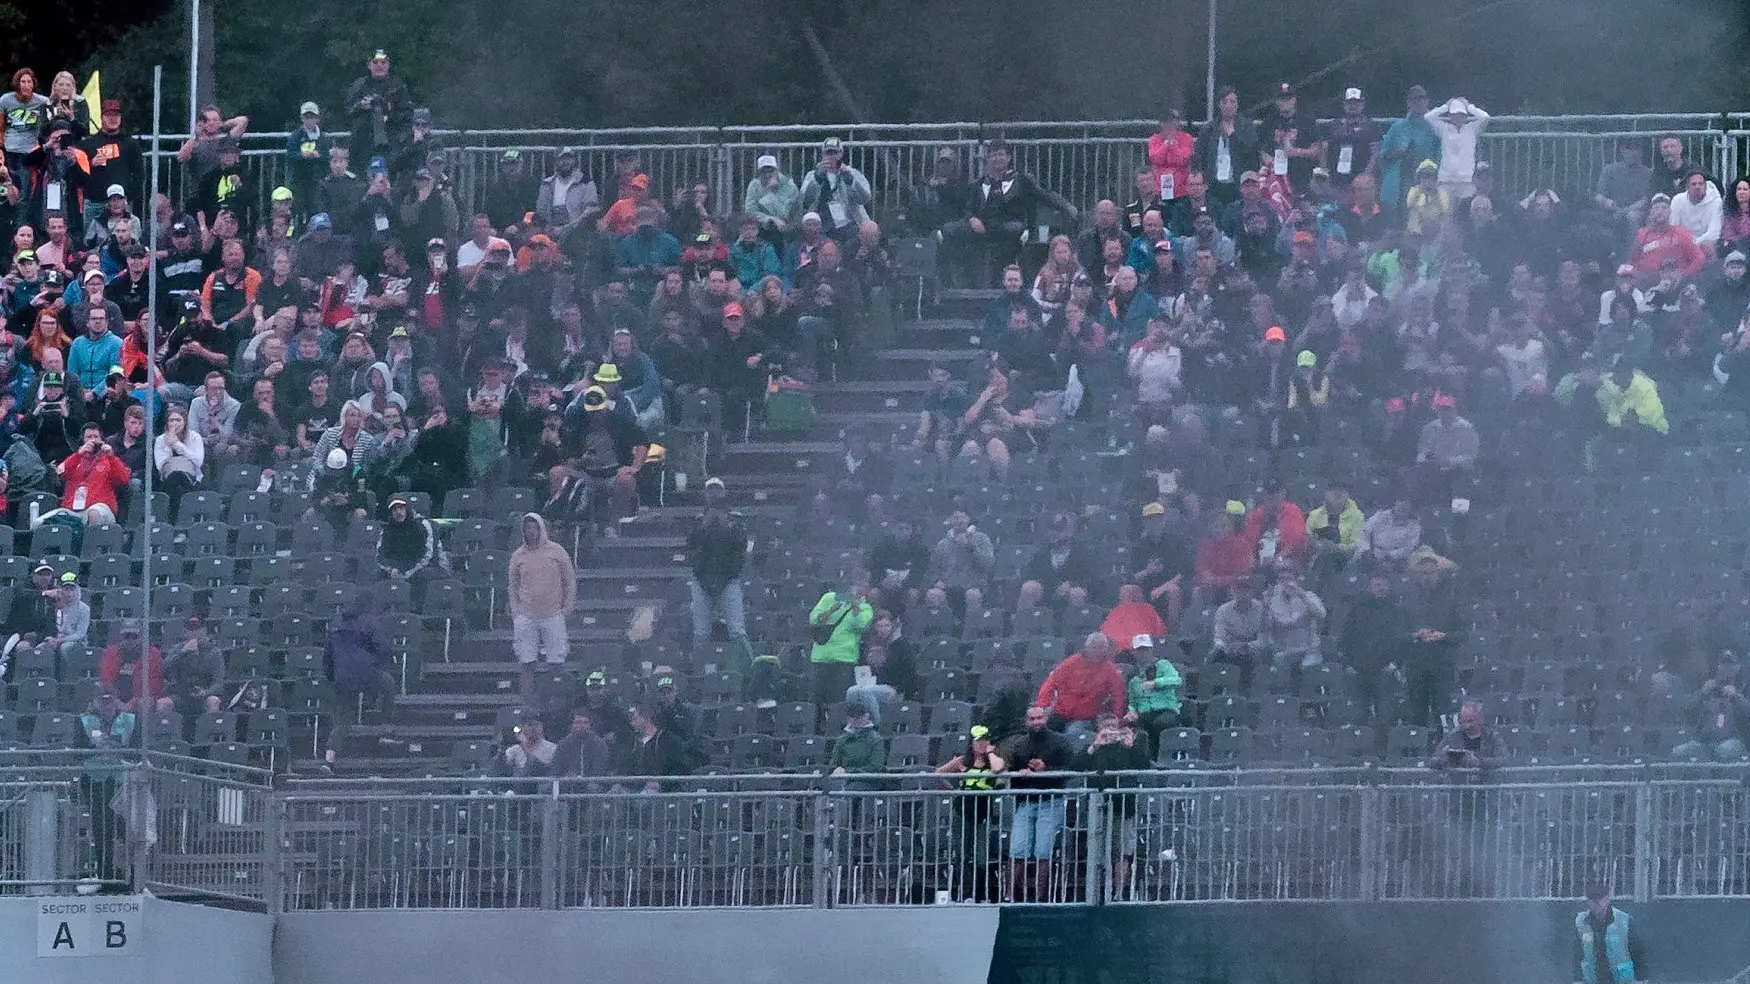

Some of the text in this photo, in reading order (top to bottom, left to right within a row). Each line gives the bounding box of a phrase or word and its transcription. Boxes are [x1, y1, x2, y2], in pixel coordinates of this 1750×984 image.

[42, 904, 87, 914] SECTOR
[94, 903, 139, 913] SECTOR
[52, 921, 75, 949] A
[106, 920, 127, 948] B
